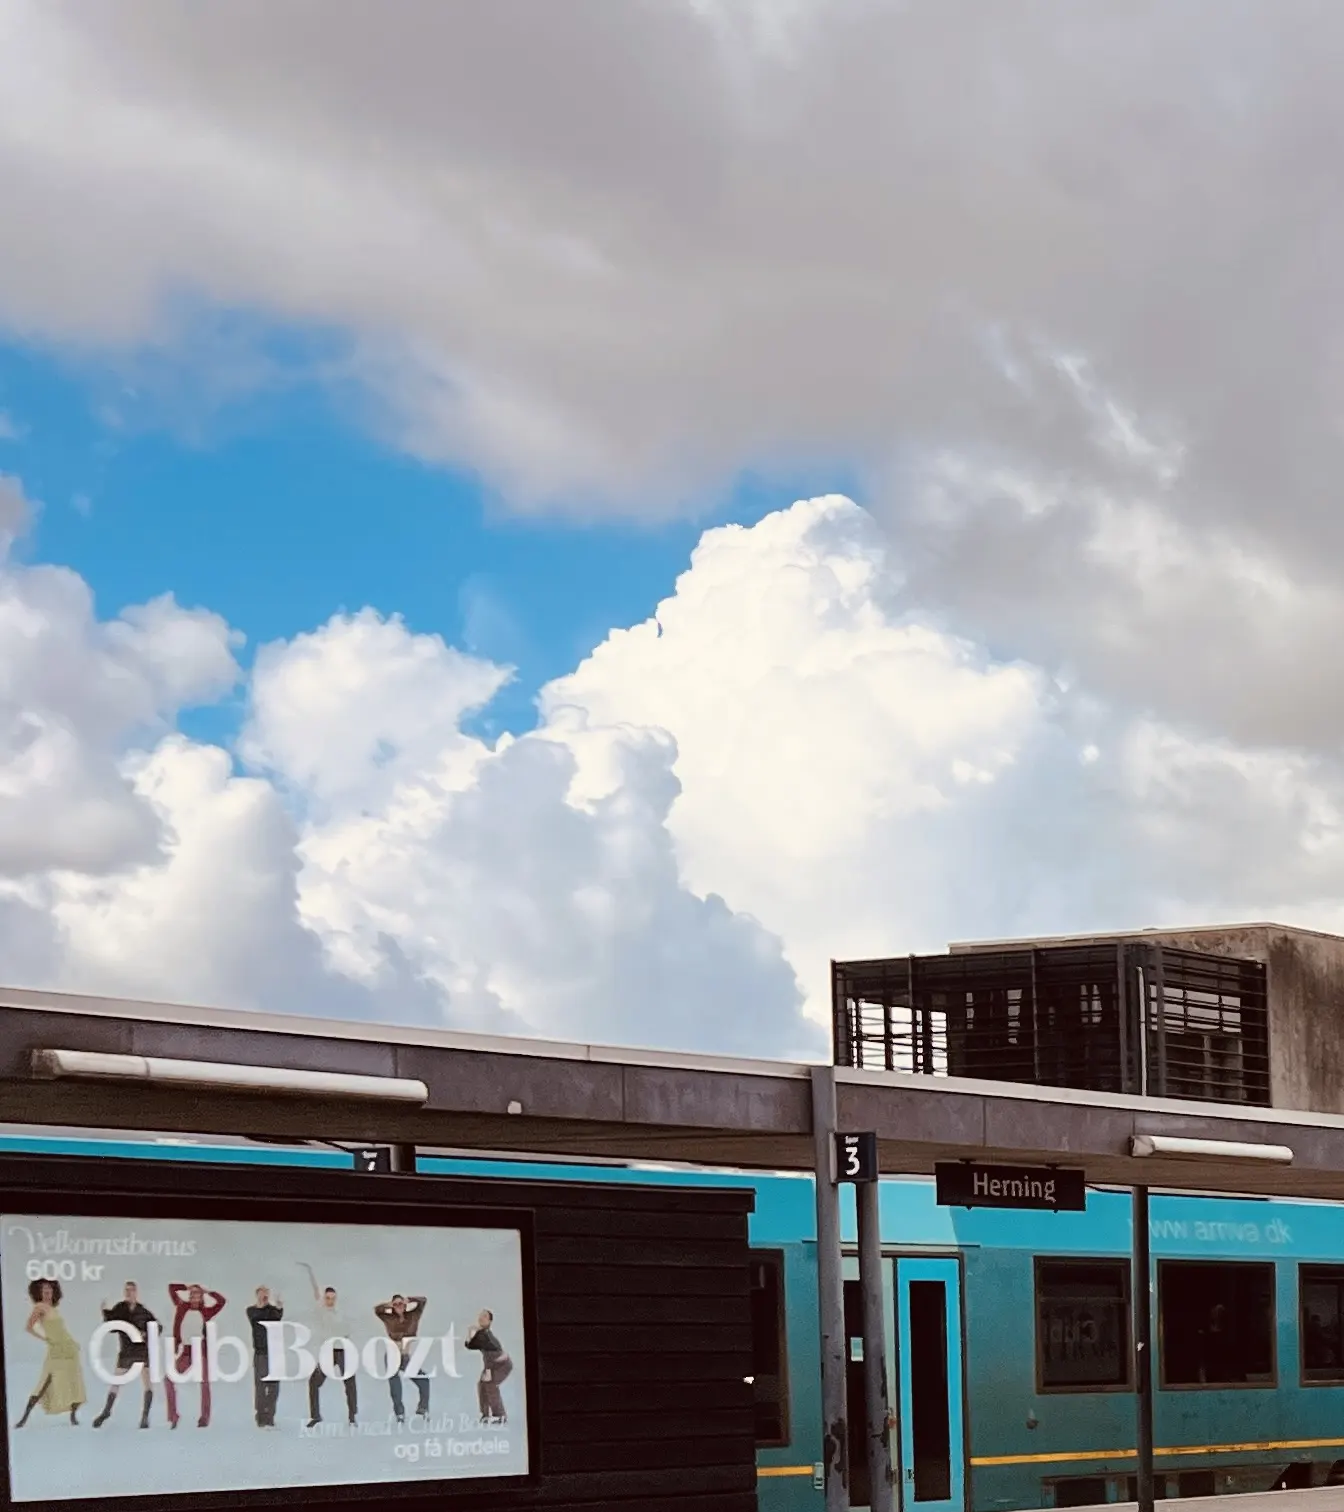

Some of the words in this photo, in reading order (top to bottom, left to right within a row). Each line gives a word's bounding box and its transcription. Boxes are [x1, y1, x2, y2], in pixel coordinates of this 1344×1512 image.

[845, 1146, 860, 1176] 3
[973, 1171, 1057, 1203] Herning
[8, 1225, 198, 1257] Velkomstbonus
[26, 1258, 77, 1282] 600
[81, 1260, 105, 1282] kr
[88, 1319, 250, 1386] Club
[258, 1319, 464, 1382] Boozt
[408, 1411, 454, 1435] Club
[393, 1442, 420, 1463] og
[424, 1437, 442, 1458] få
[446, 1435, 510, 1457] fordele
